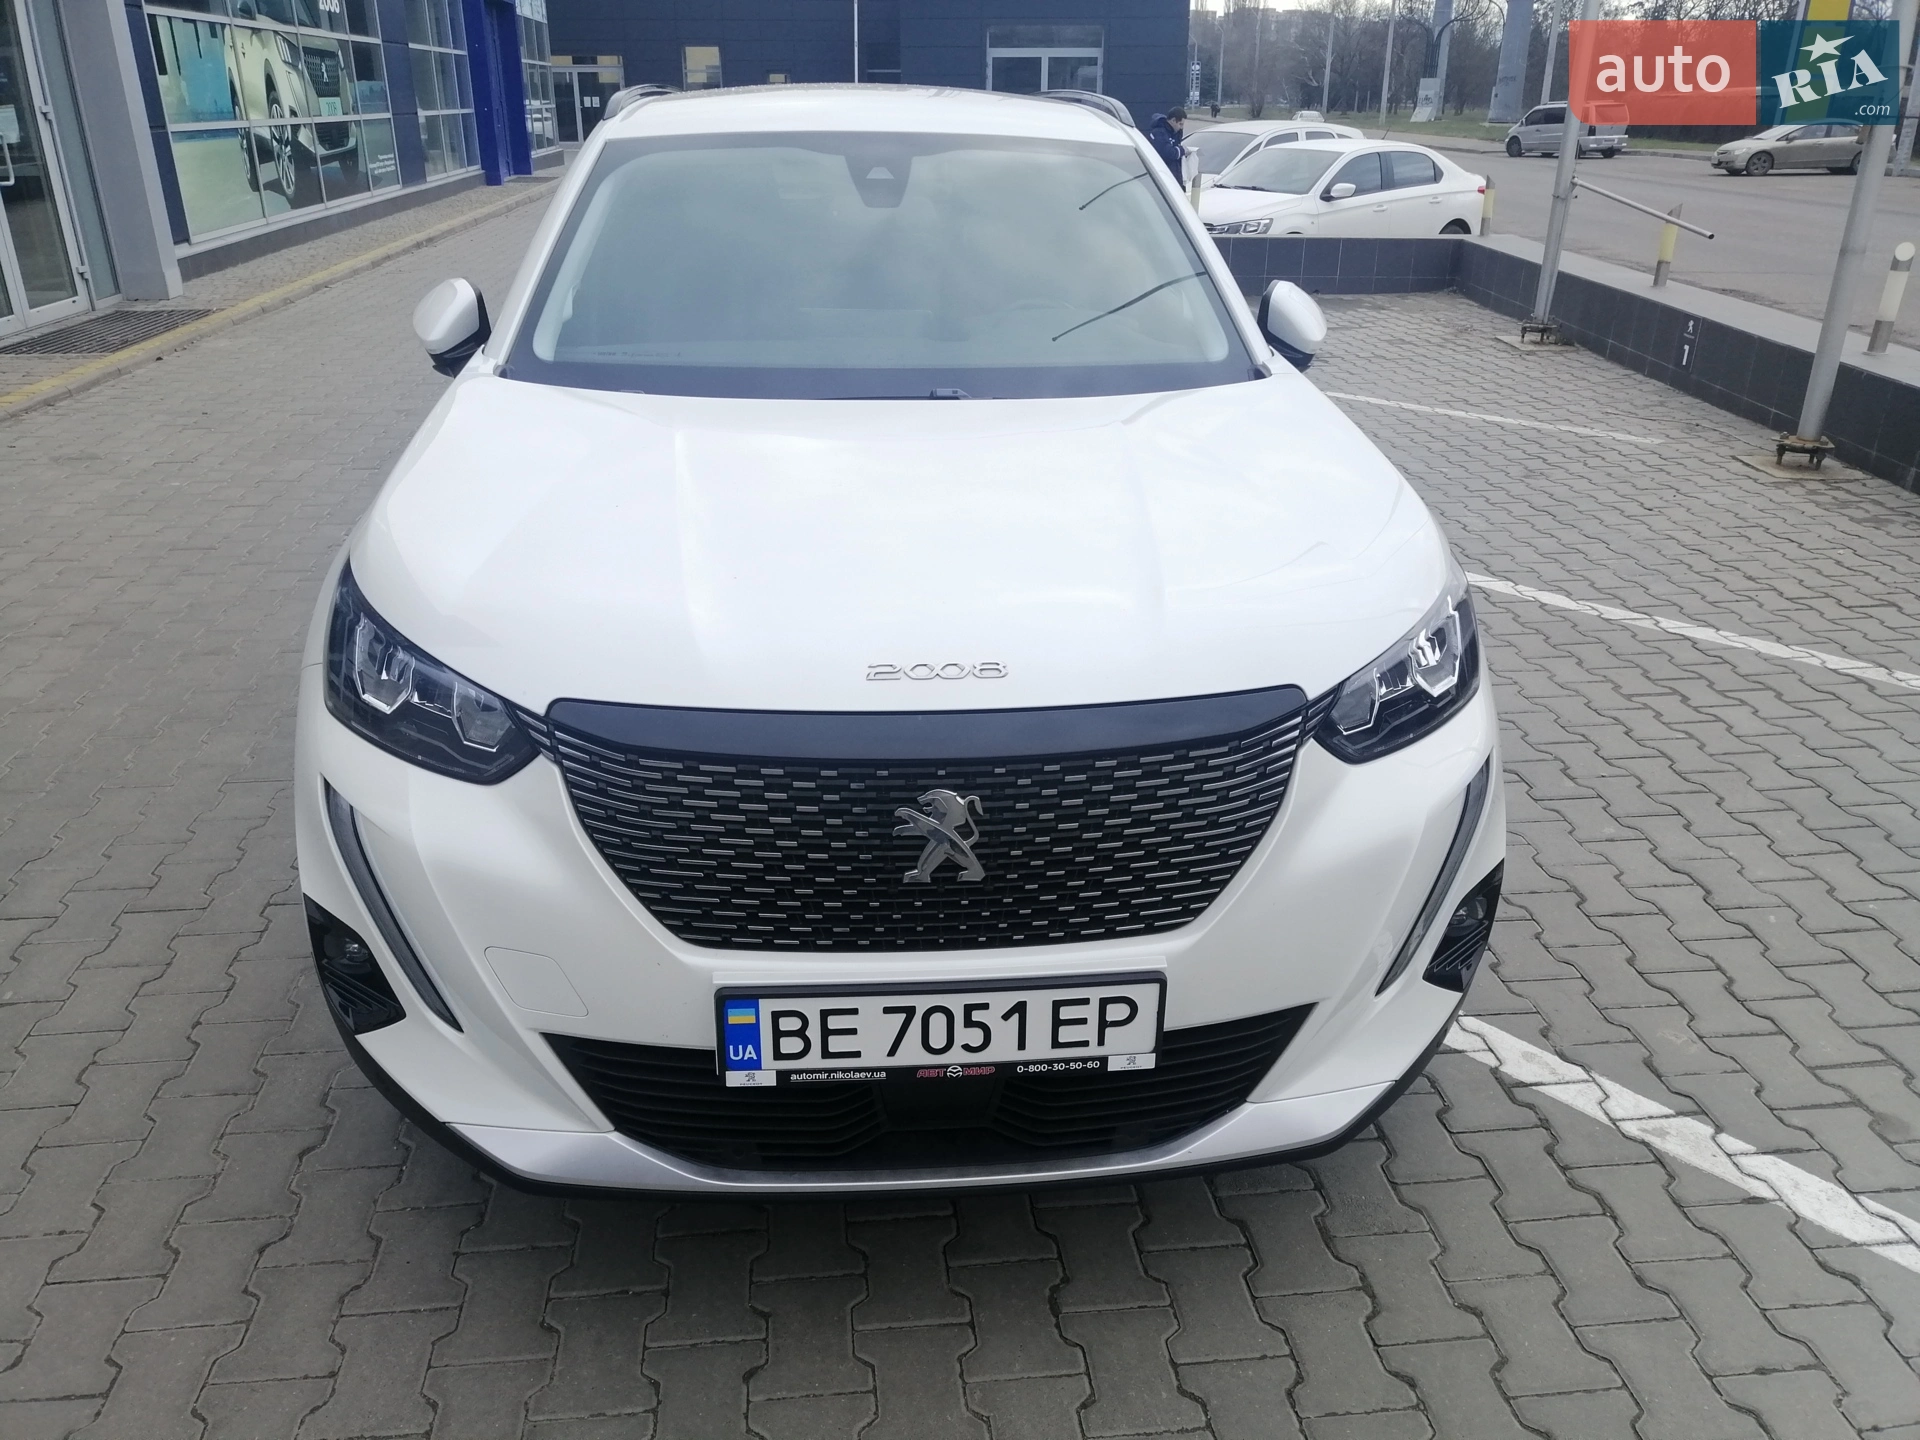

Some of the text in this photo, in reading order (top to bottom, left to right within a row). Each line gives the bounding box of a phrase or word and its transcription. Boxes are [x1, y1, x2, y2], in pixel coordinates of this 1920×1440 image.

[1682, 344, 1690, 366] 1
[865, 660, 1009, 681] 2008
[771, 996, 1139, 1061] BE 7051 EP
[729, 1044, 757, 1060] UA
[790, 1070, 887, 1081] automir.nikolaev.ua
[1016, 1060, 1100, 1073] 0-800-30-50-60
